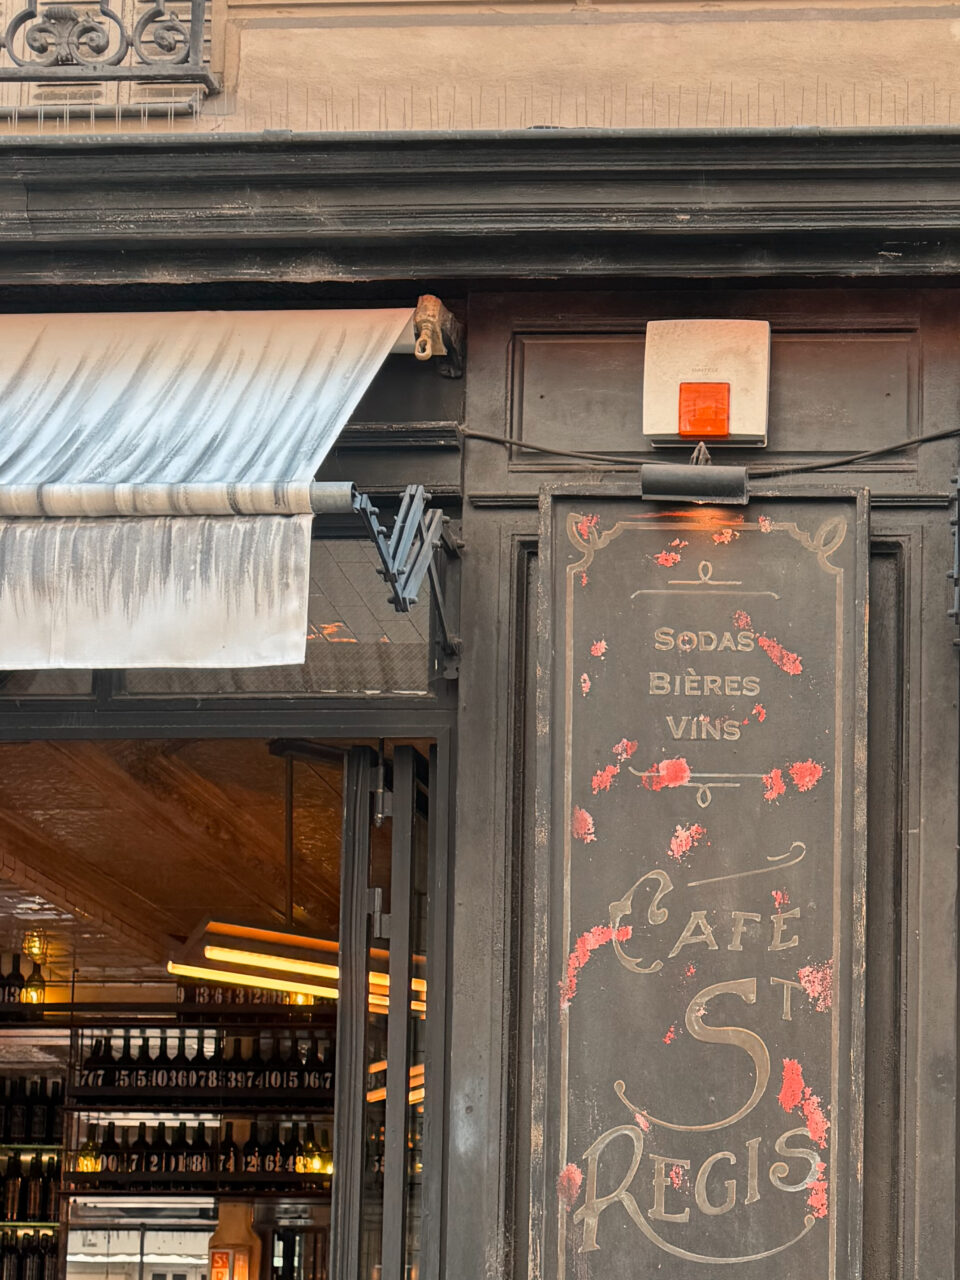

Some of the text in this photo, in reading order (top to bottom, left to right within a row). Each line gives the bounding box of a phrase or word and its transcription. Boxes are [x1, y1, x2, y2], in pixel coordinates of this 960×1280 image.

[653, 627, 756, 652] SODAS
[649, 668, 761, 696] BIÈRES
[666, 715, 742, 741] VINS
[573, 1125, 822, 1264] REGIS
